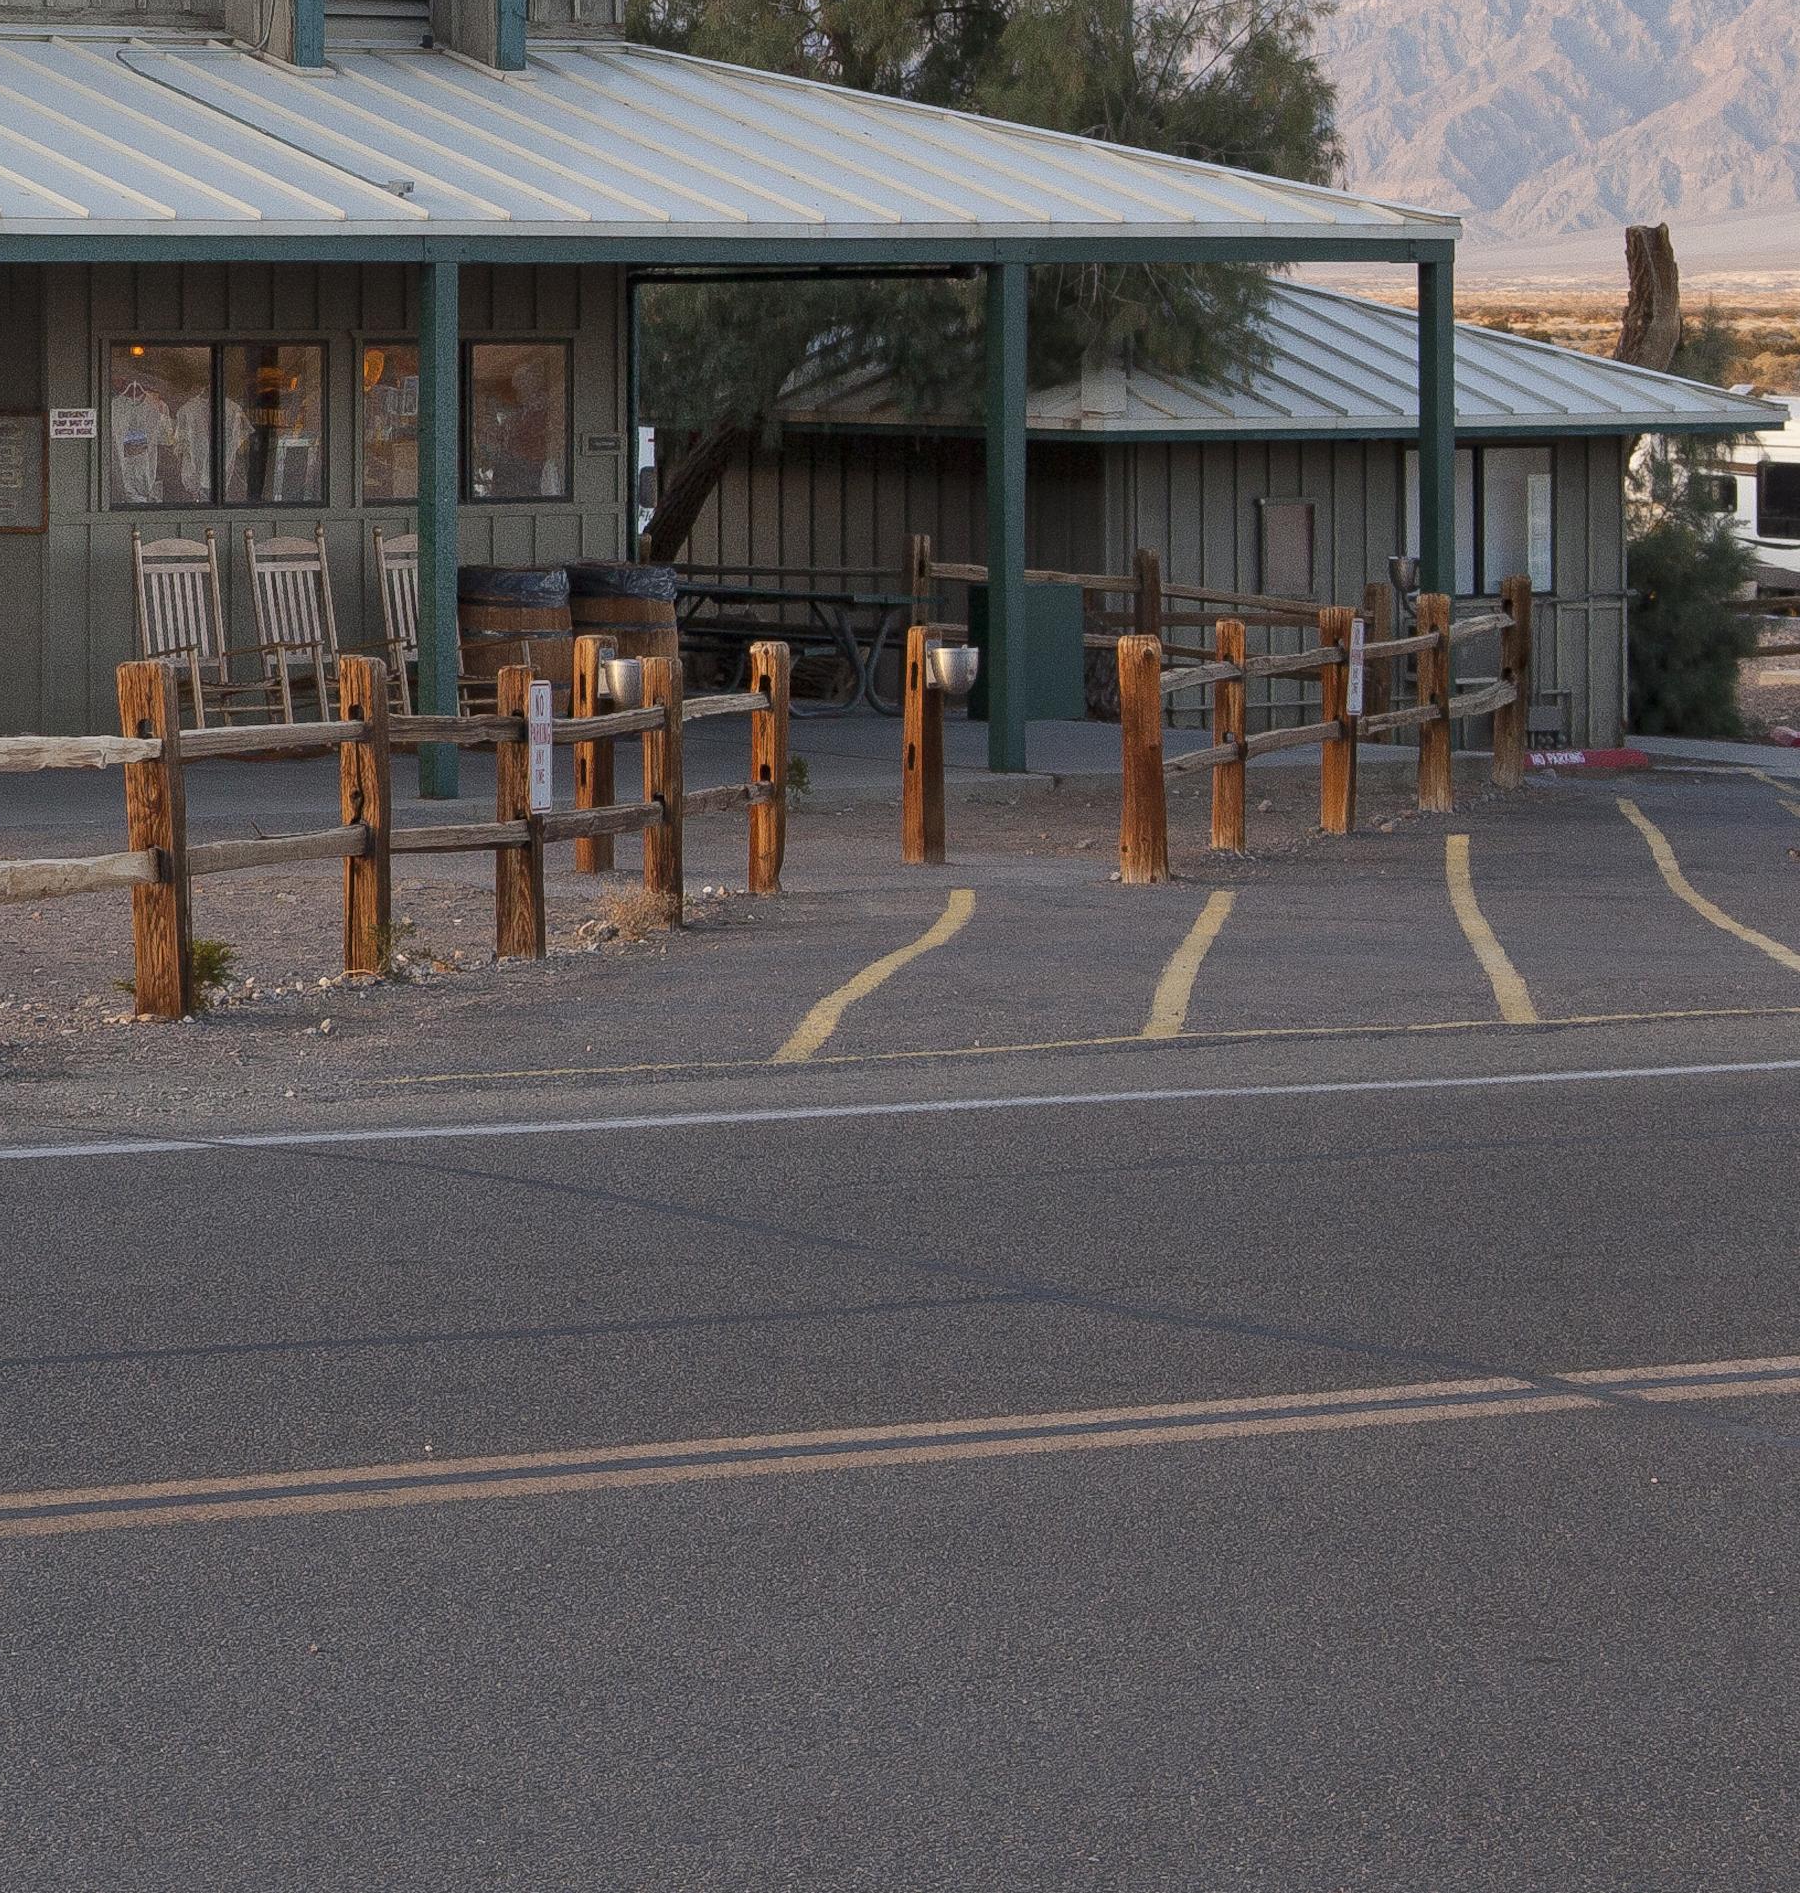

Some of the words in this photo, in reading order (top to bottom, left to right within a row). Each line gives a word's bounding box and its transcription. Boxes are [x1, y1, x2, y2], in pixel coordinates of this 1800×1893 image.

[535, 693, 545, 717] NO
[1530, 753, 1546, 766] NO
[1546, 751, 1586, 765] PARKING
